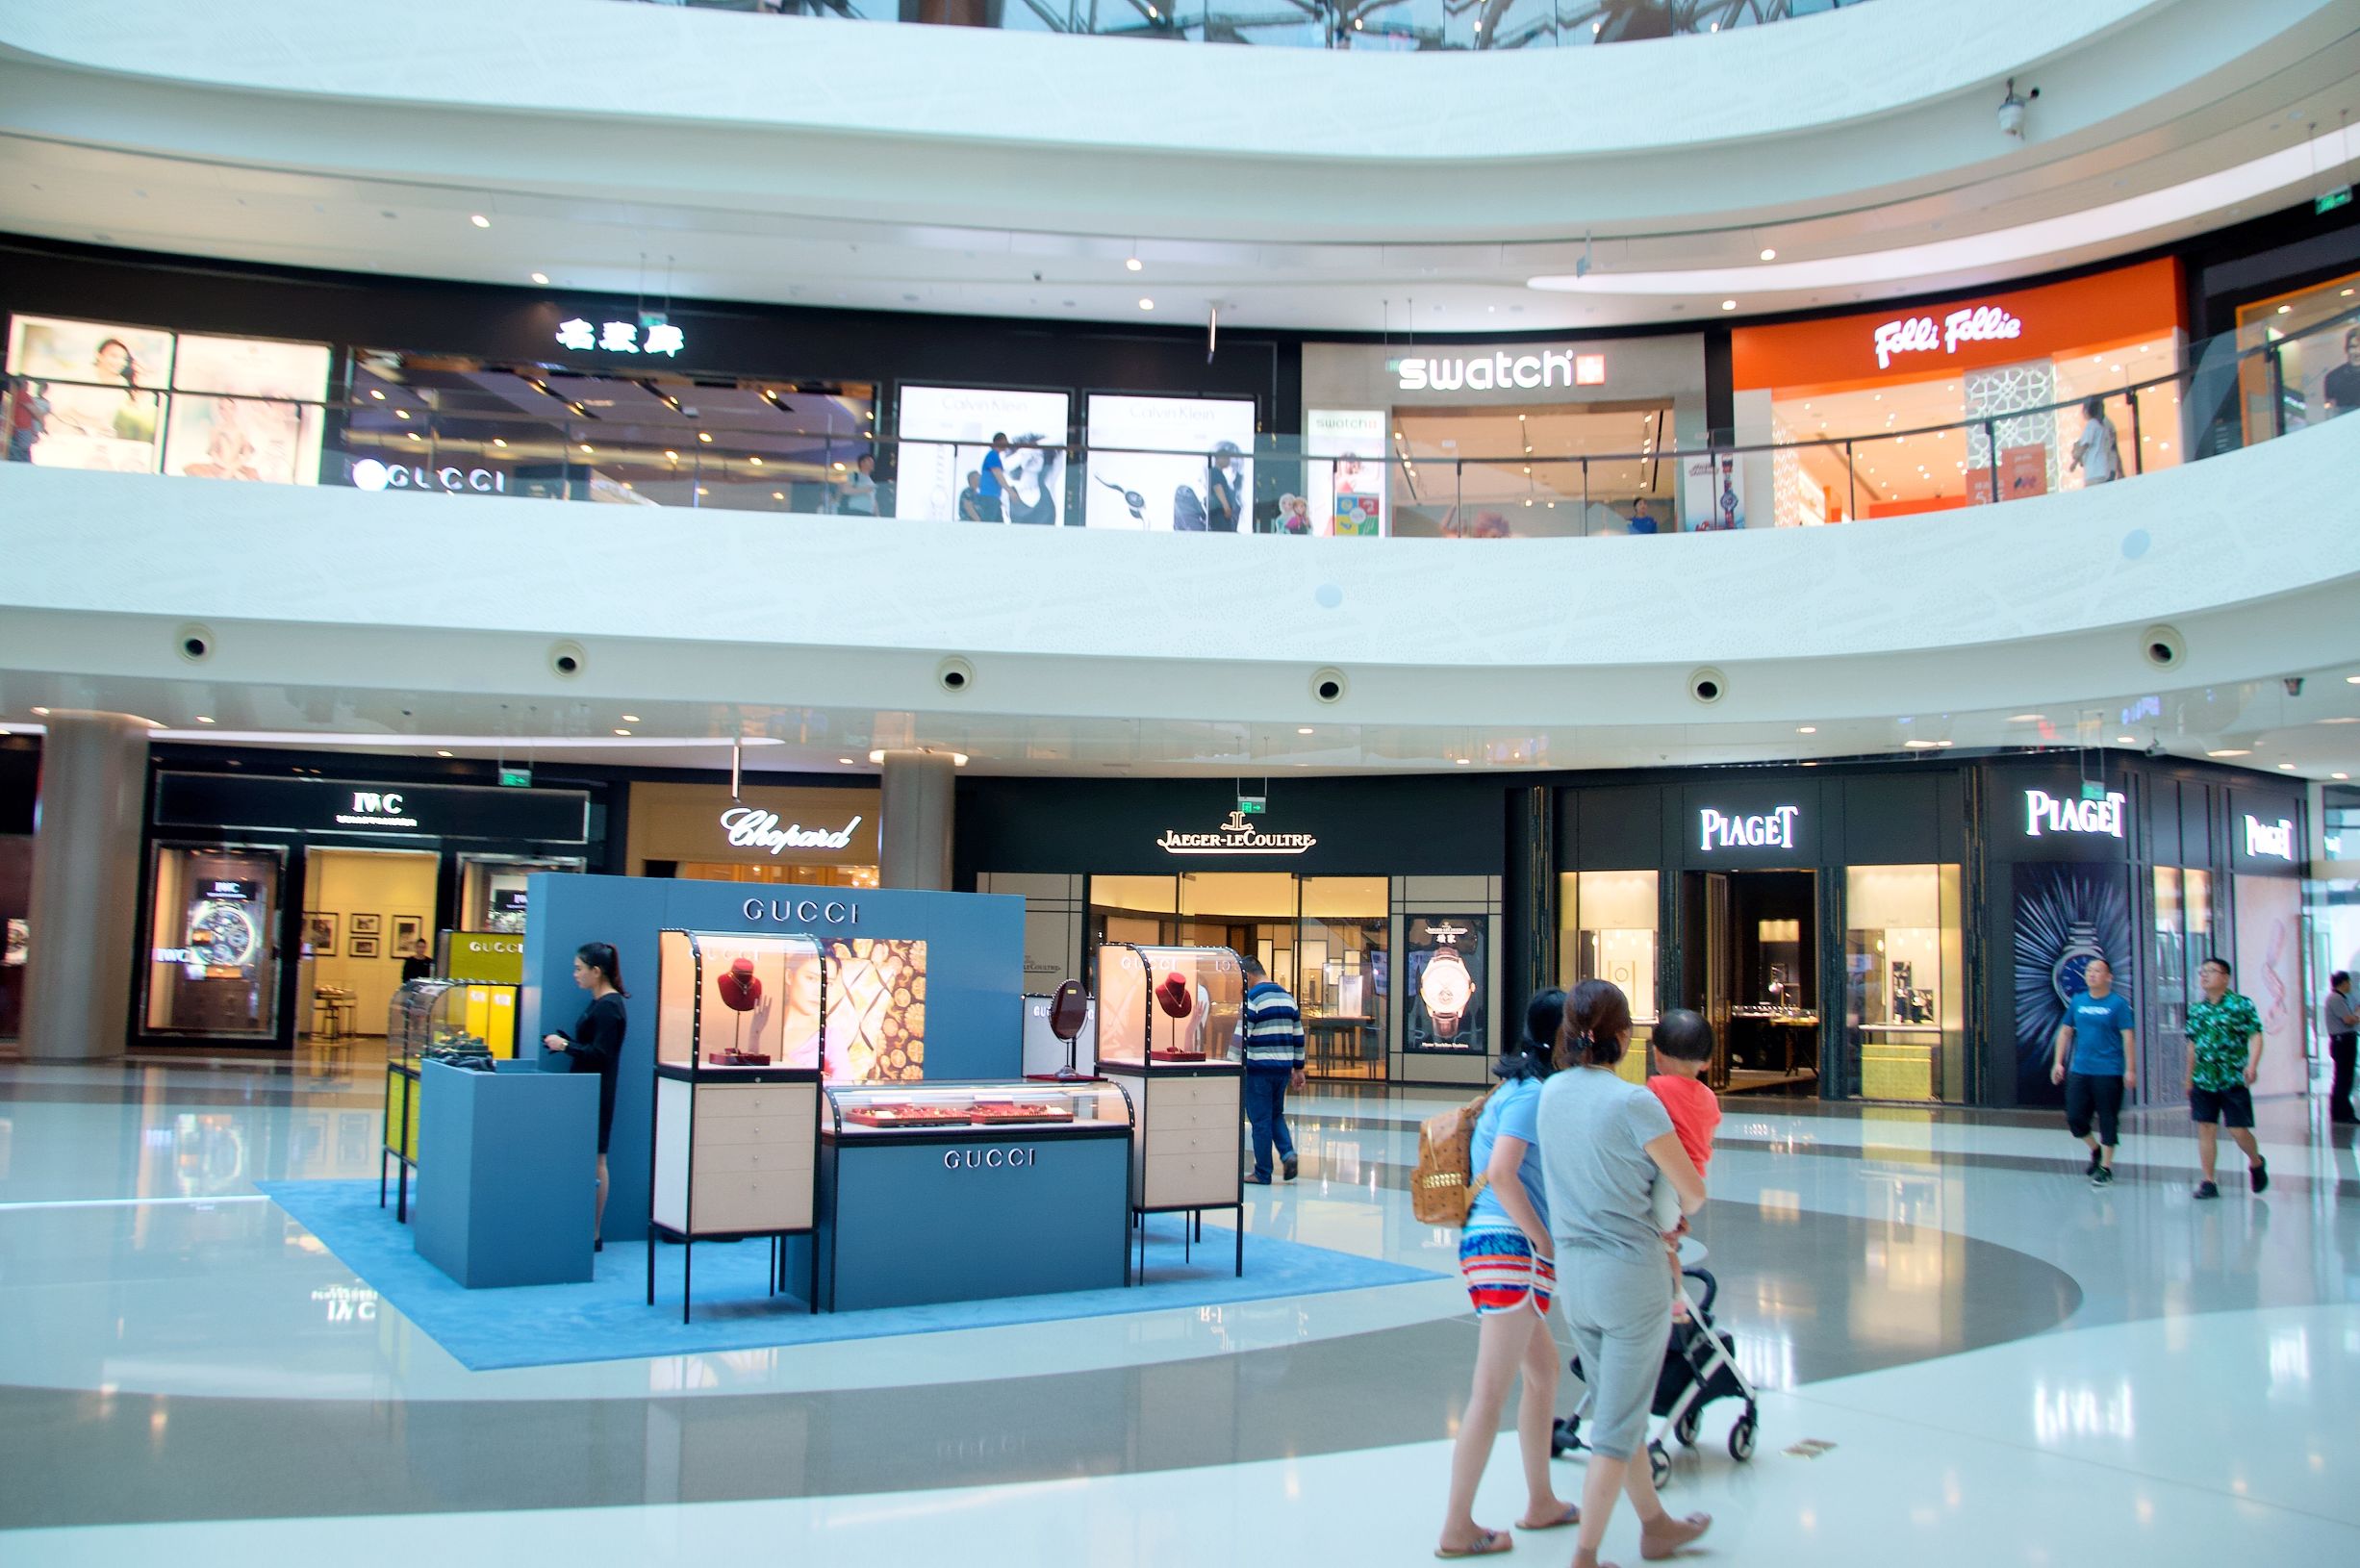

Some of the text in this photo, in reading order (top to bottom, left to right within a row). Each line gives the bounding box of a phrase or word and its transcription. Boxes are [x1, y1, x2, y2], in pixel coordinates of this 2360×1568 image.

[1874, 305, 2021, 369] Folli Follie
[1398, 349, 1573, 391] swatch
[352, 792, 403, 814] IWC
[2023, 790, 2126, 838] PIAGET
[720, 807, 862, 855] Chopard
[1700, 805, 1799, 851] PIAGET
[743, 898, 858, 924] GUCCI
[469, 941, 523, 954] GUCCI
[944, 1148, 1035, 1169] GUCCI
